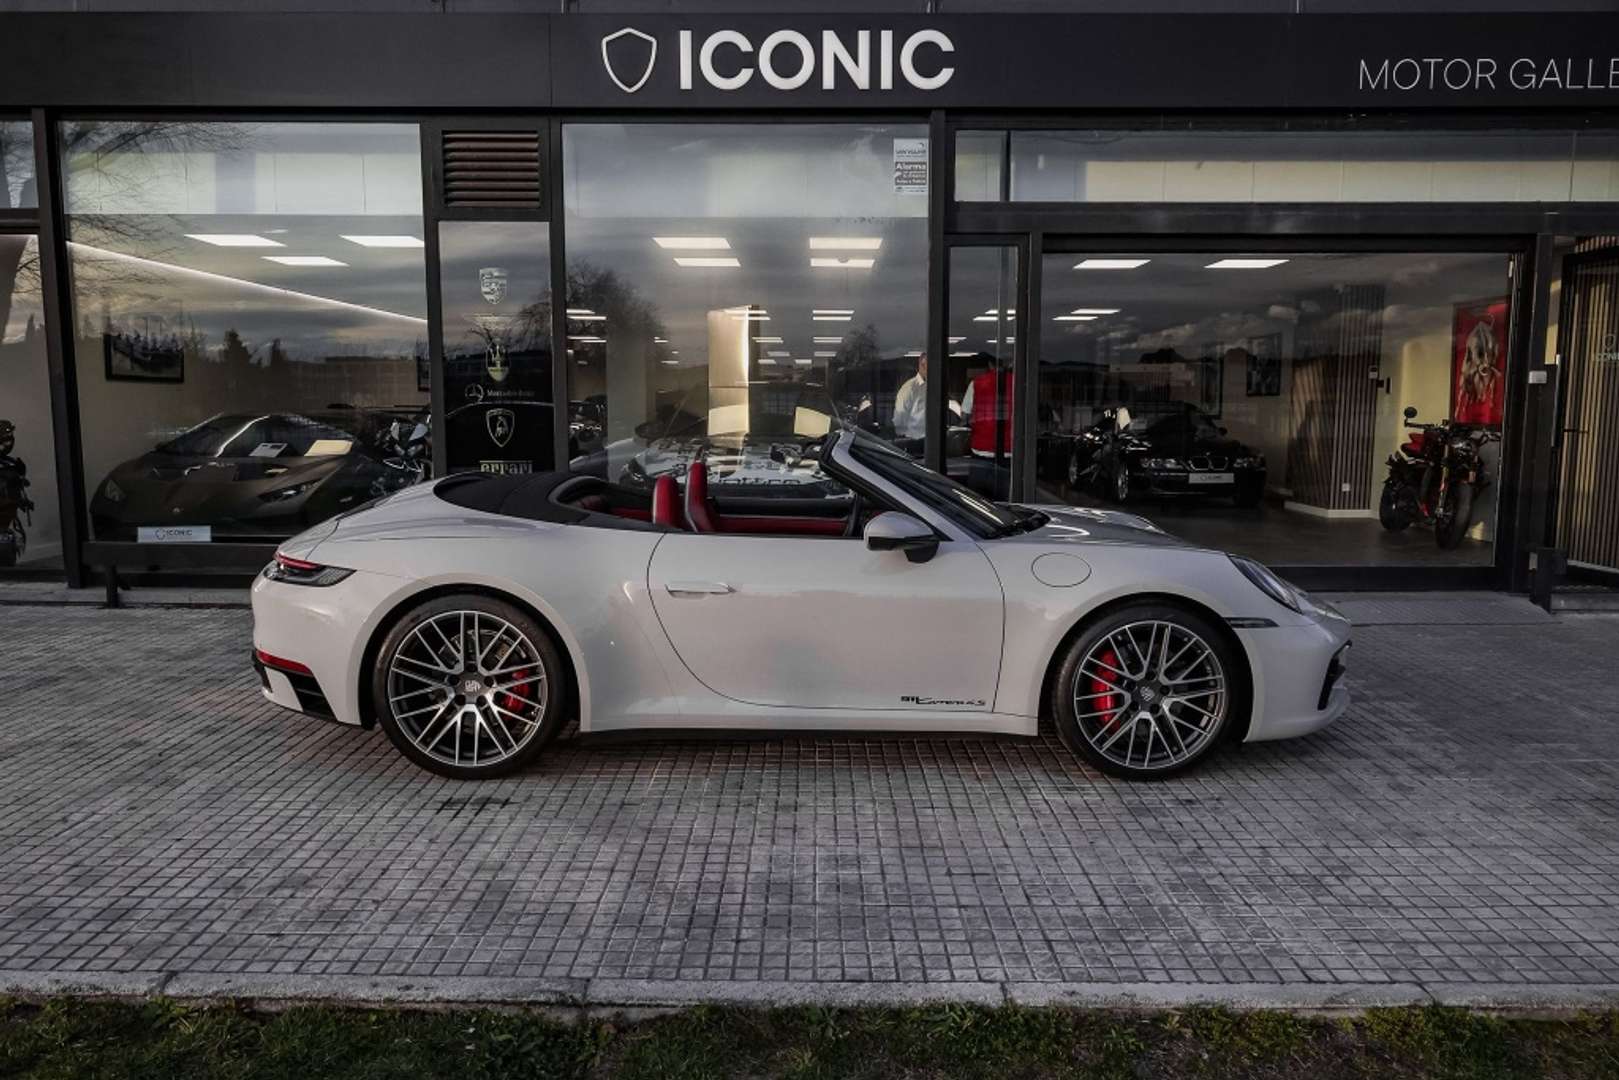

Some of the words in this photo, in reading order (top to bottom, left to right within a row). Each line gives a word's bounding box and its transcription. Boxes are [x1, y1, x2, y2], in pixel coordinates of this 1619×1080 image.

[680, 29, 955, 90] ICONIC
[1359, 58, 1497, 90] MOTOR
[1509, 58, 1619, 90] GALLE
